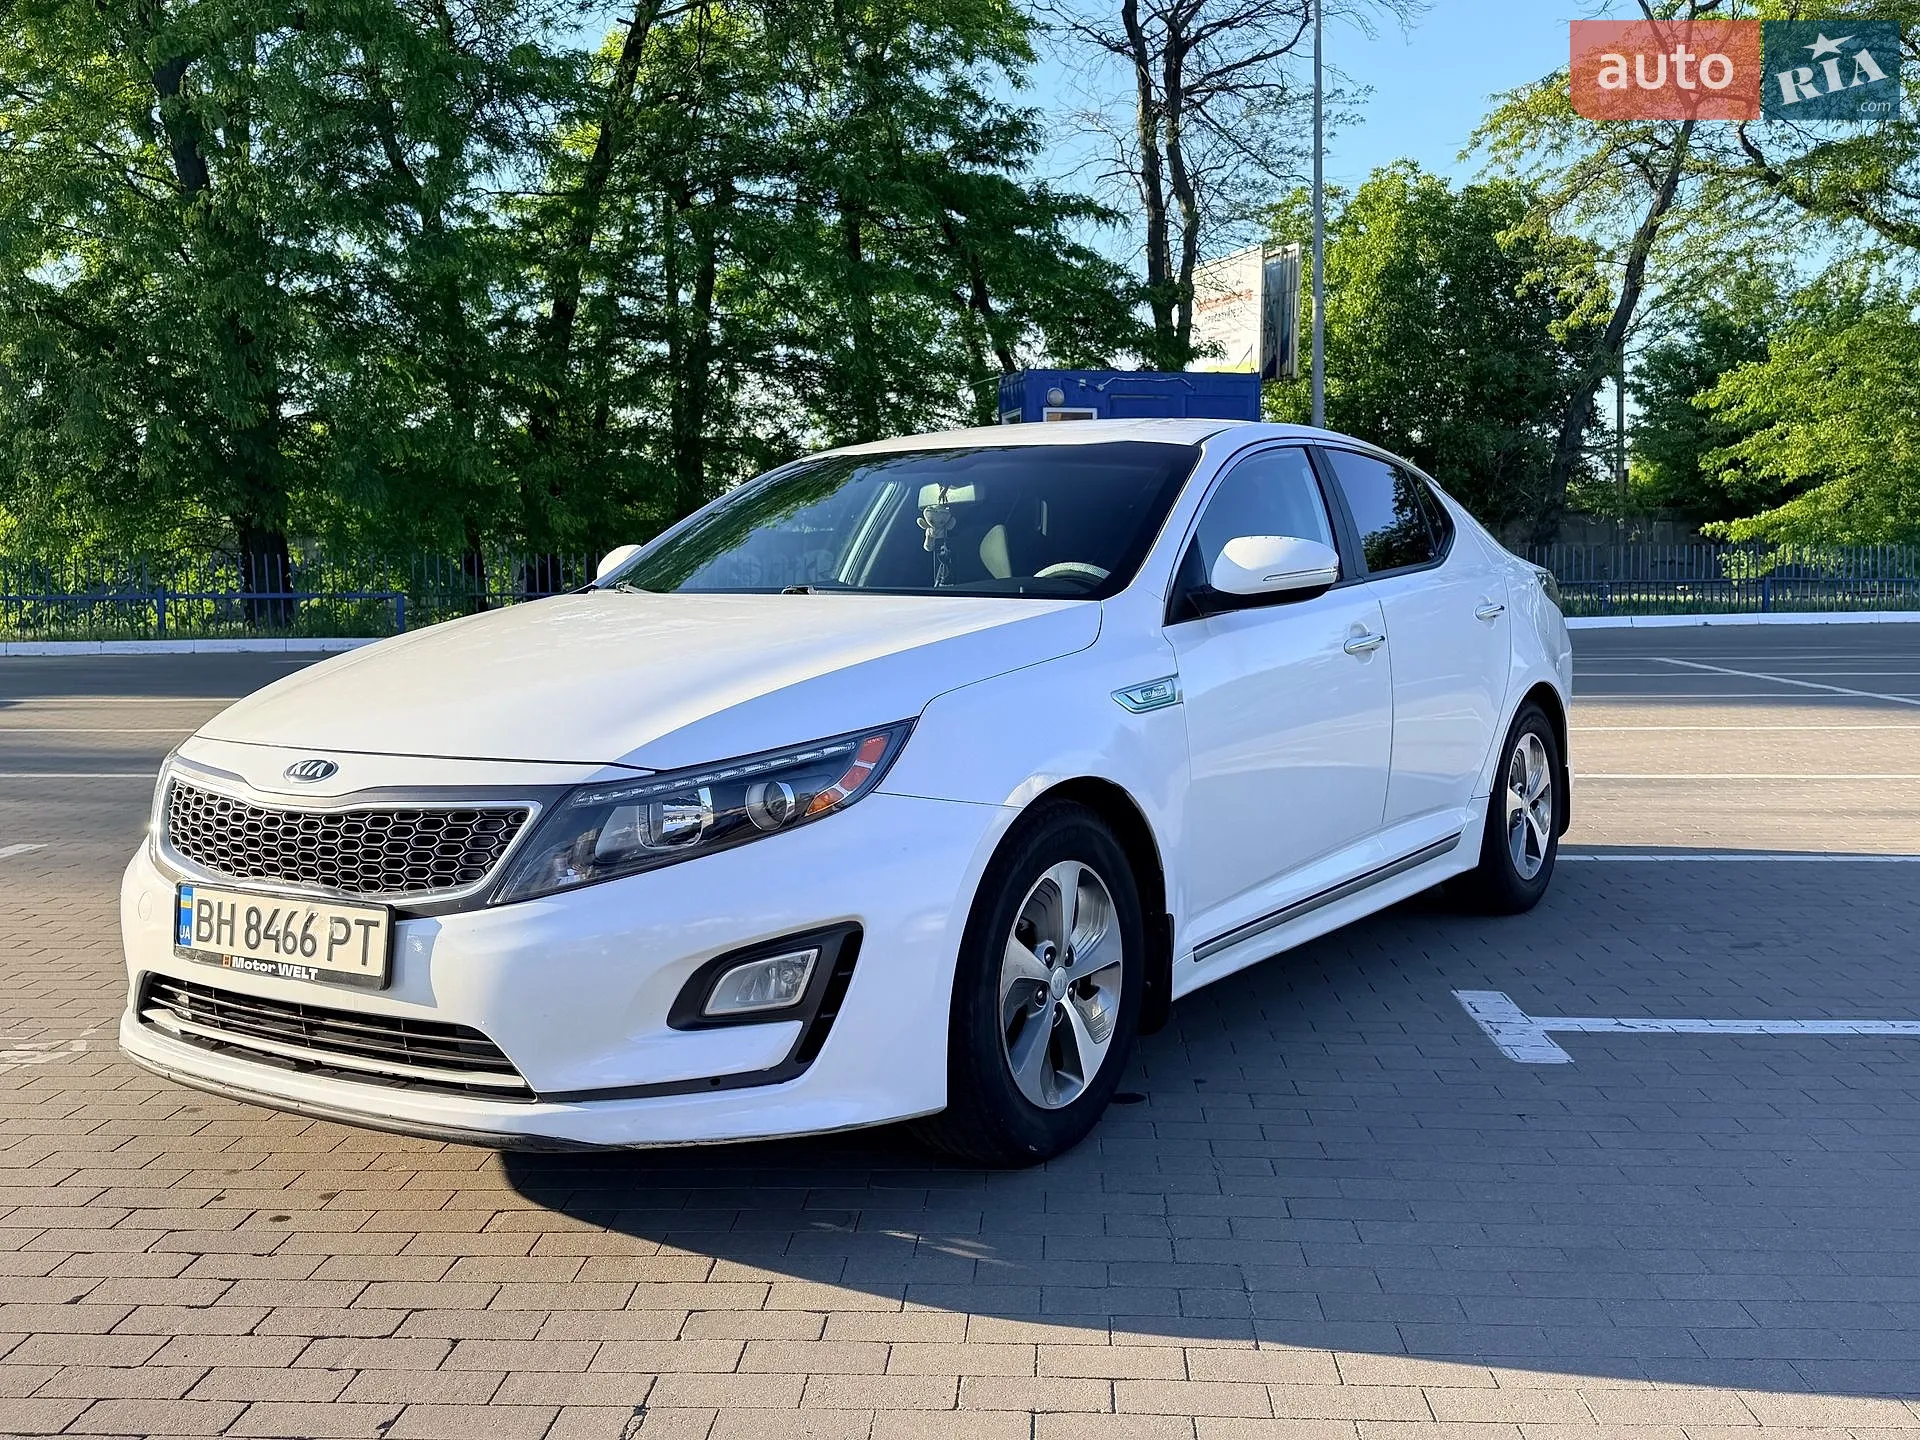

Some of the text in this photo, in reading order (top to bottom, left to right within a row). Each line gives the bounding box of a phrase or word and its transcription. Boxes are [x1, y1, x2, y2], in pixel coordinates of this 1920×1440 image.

[289, 761, 327, 777] KIA
[180, 924, 191, 940] UA
[196, 899, 380, 966] BH 8466 PT
[232, 956, 319, 980] Motor WELT
